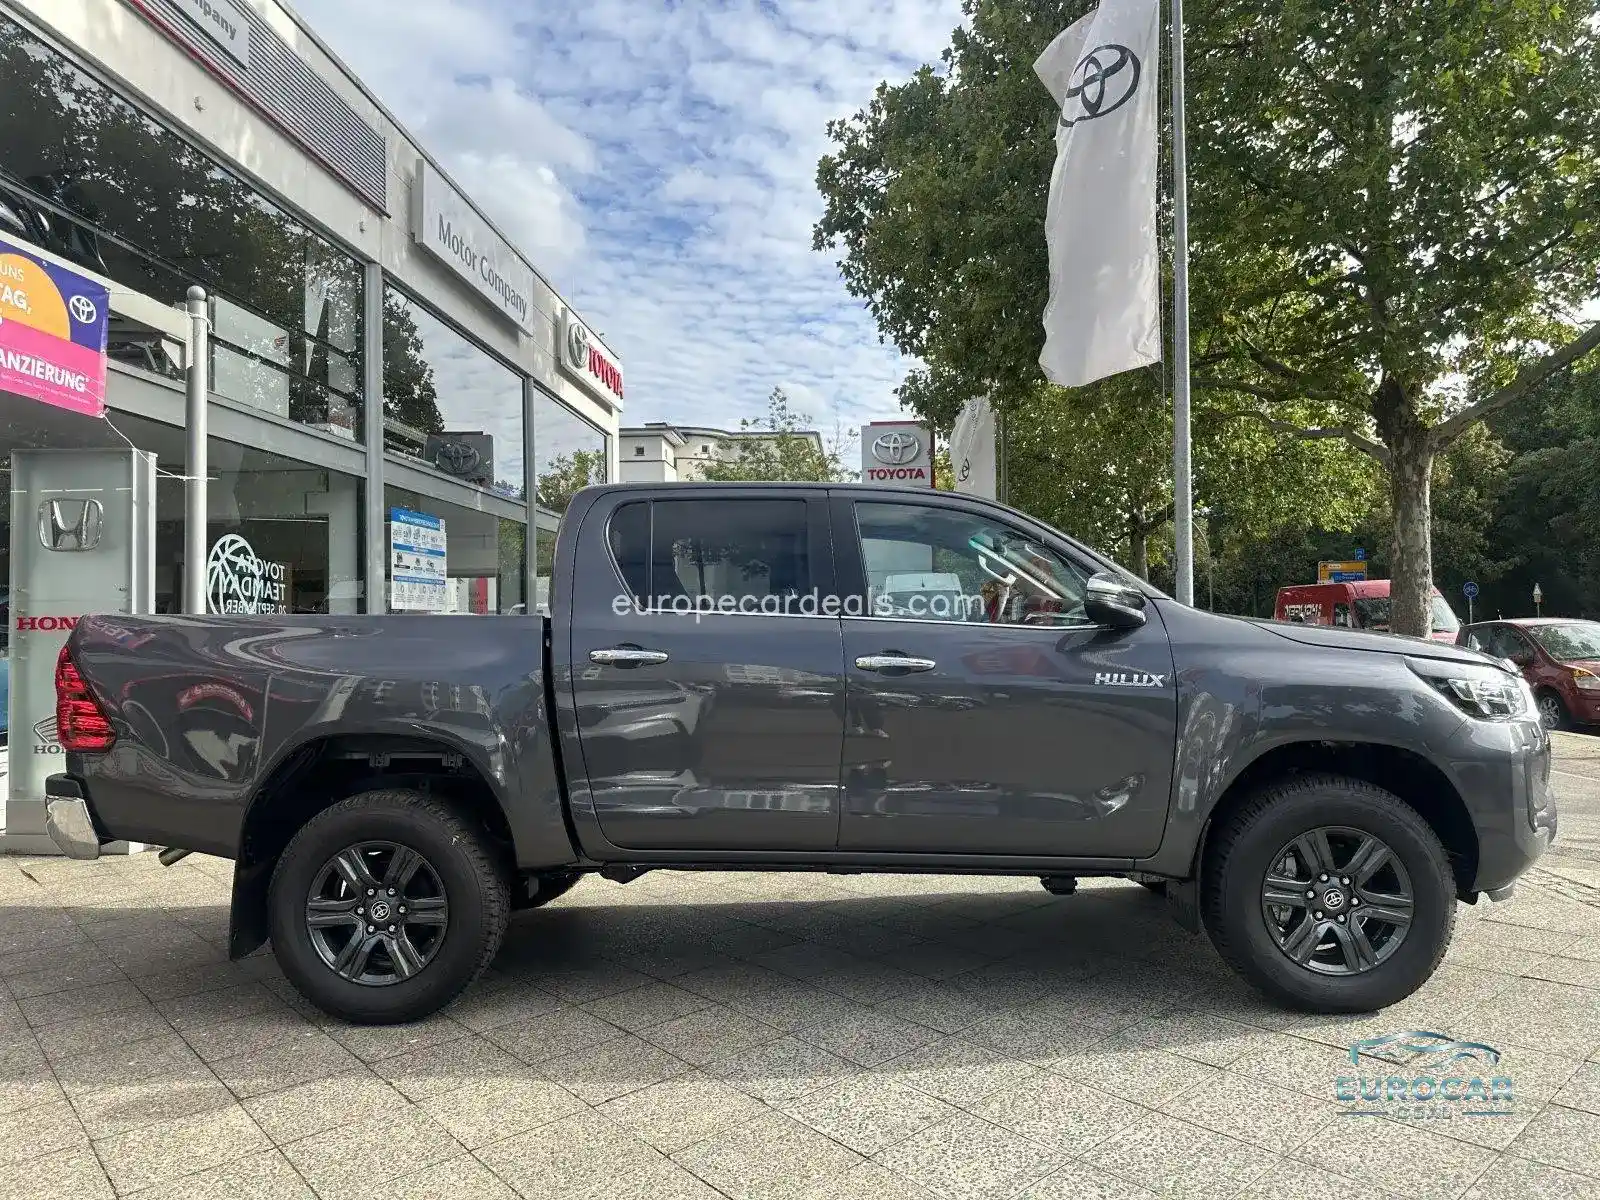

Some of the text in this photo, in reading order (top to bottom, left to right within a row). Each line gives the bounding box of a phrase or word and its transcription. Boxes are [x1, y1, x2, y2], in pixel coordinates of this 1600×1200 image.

[438, 212, 528, 322] Motor Company
[588, 343, 624, 400] TOYOTA
[868, 467, 926, 481] TOYOTA
[16, 616, 79, 631] HON
[1094, 672, 1166, 688] HILUX
